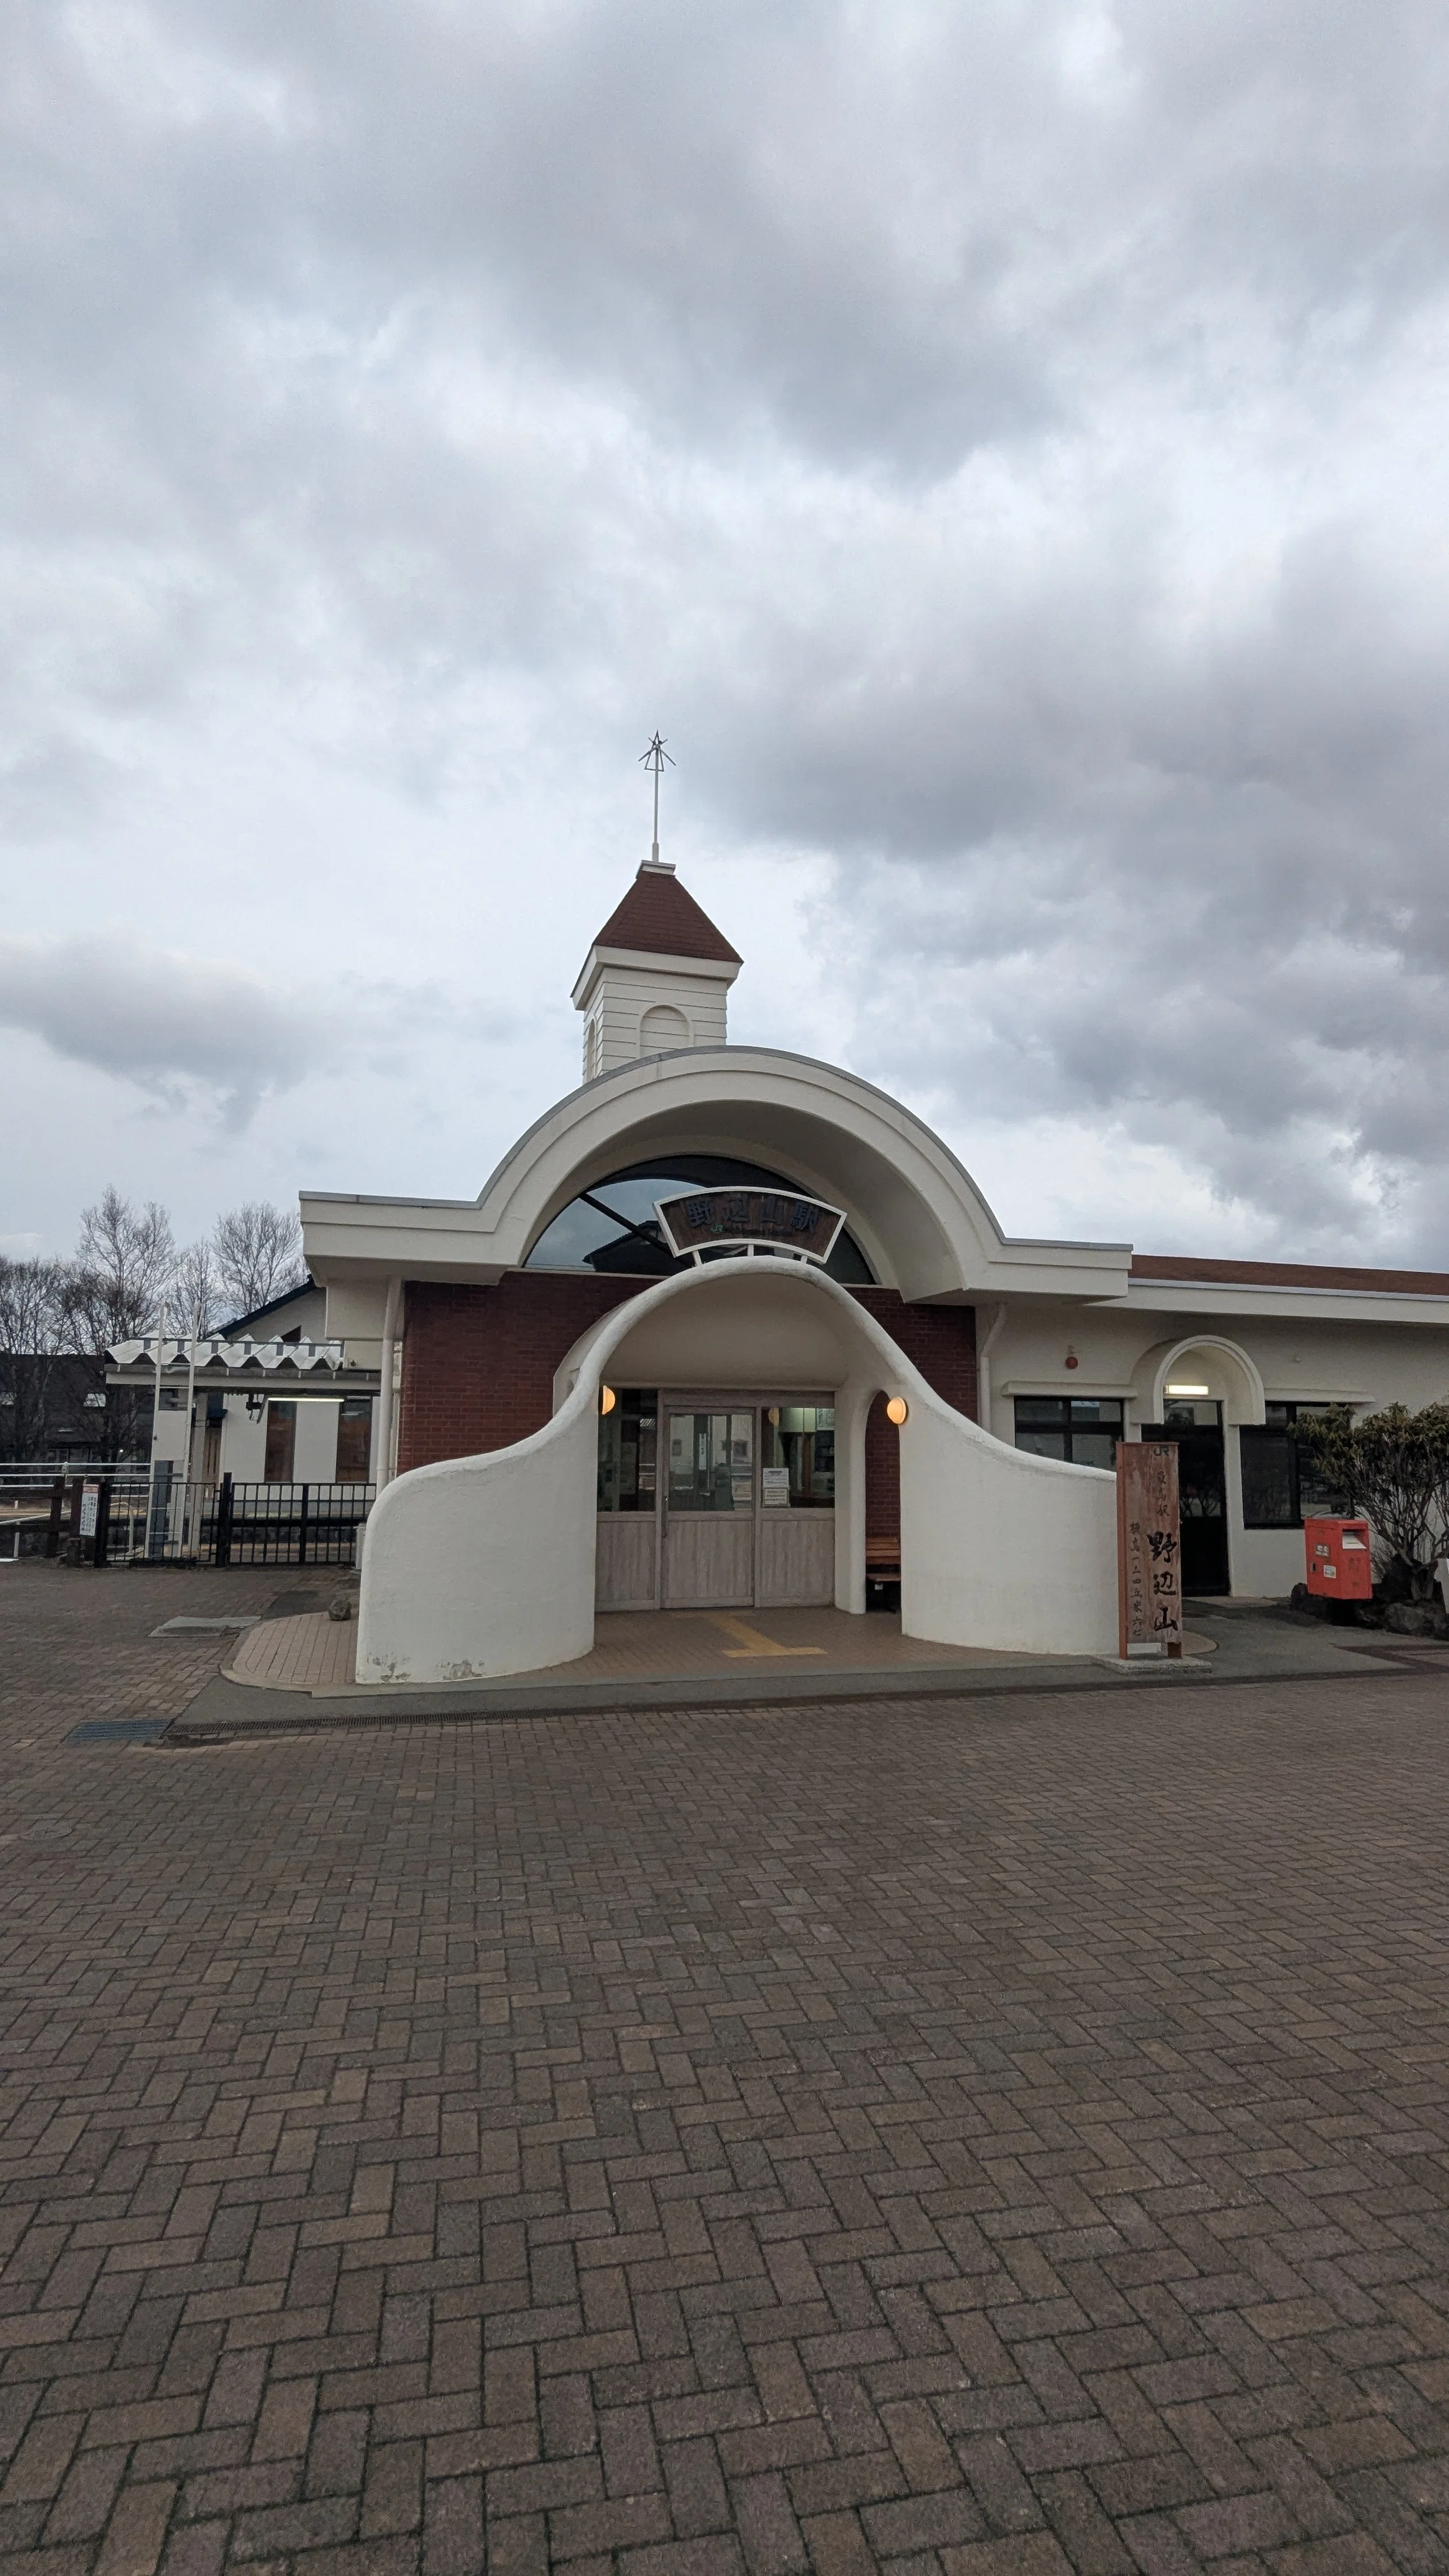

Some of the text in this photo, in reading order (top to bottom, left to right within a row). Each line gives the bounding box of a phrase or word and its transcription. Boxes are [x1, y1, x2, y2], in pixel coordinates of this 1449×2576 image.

[686, 1193, 821, 1233] 野辺山駅
[710, 1224, 724, 1233] JR
[1153, 1446, 1169, 1457] JR
[1146, 1530, 1179, 1632] 野辺山
